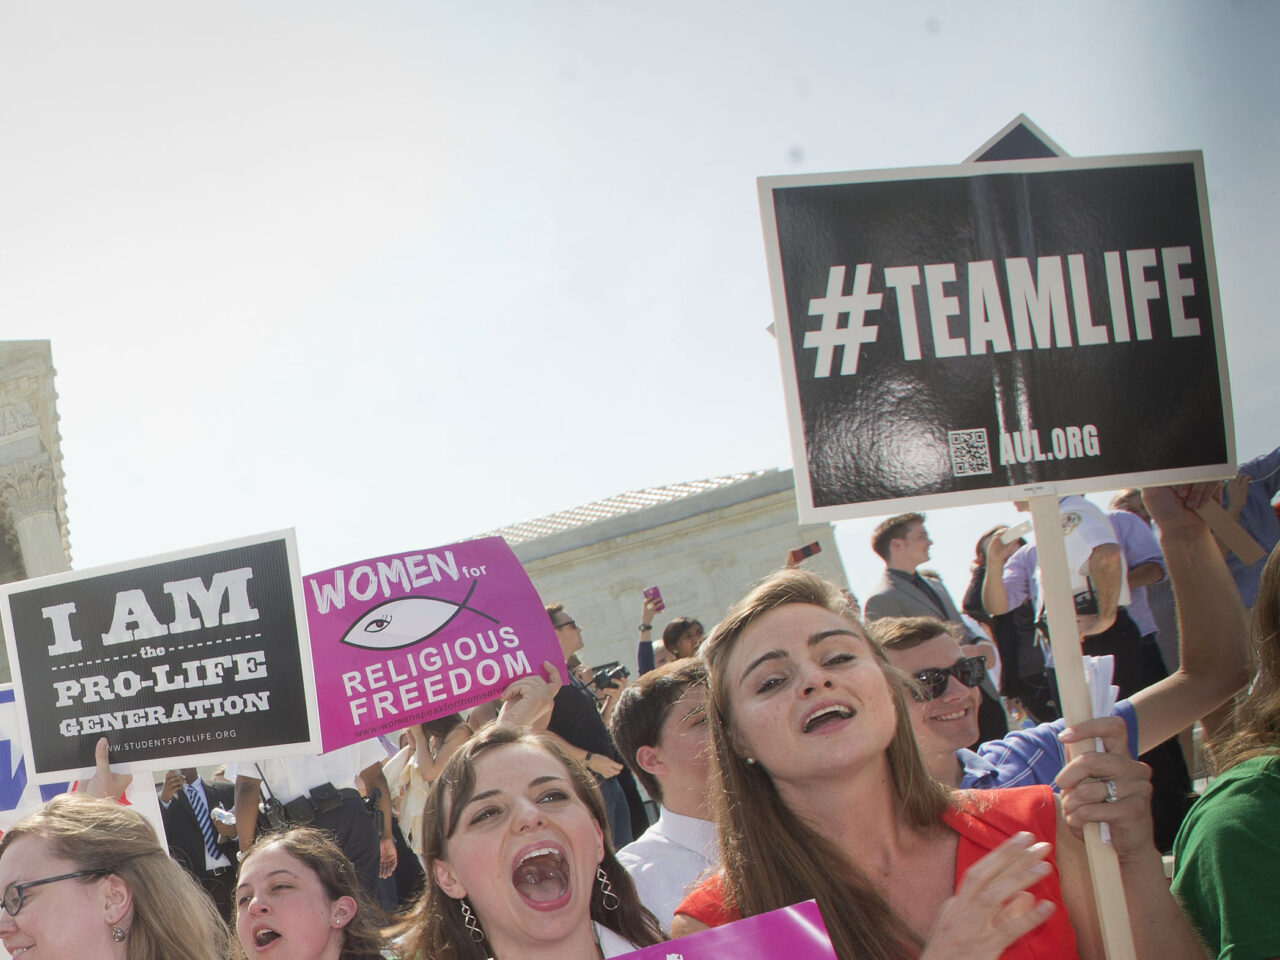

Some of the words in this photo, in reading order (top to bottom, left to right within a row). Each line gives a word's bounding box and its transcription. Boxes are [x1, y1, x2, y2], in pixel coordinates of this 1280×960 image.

[802, 245, 1201, 379] #TEAMLIFE
[998, 423, 1101, 466] AUL.ORG
[41, 602, 83, 656] I
[101, 567, 260, 646] AM
[310, 551, 461, 615] WOMEN
[462, 564, 487, 579] for
[53, 650, 268, 708] PRO-LIFE
[140, 645, 165, 659] the
[342, 626, 520, 697] RELIGIOUS
[59, 691, 270, 737] GENERATION
[349, 650, 533, 726] FREEDOM
[107, 729, 237, 752] WW.STUDENTSFORLIFE.ORG
